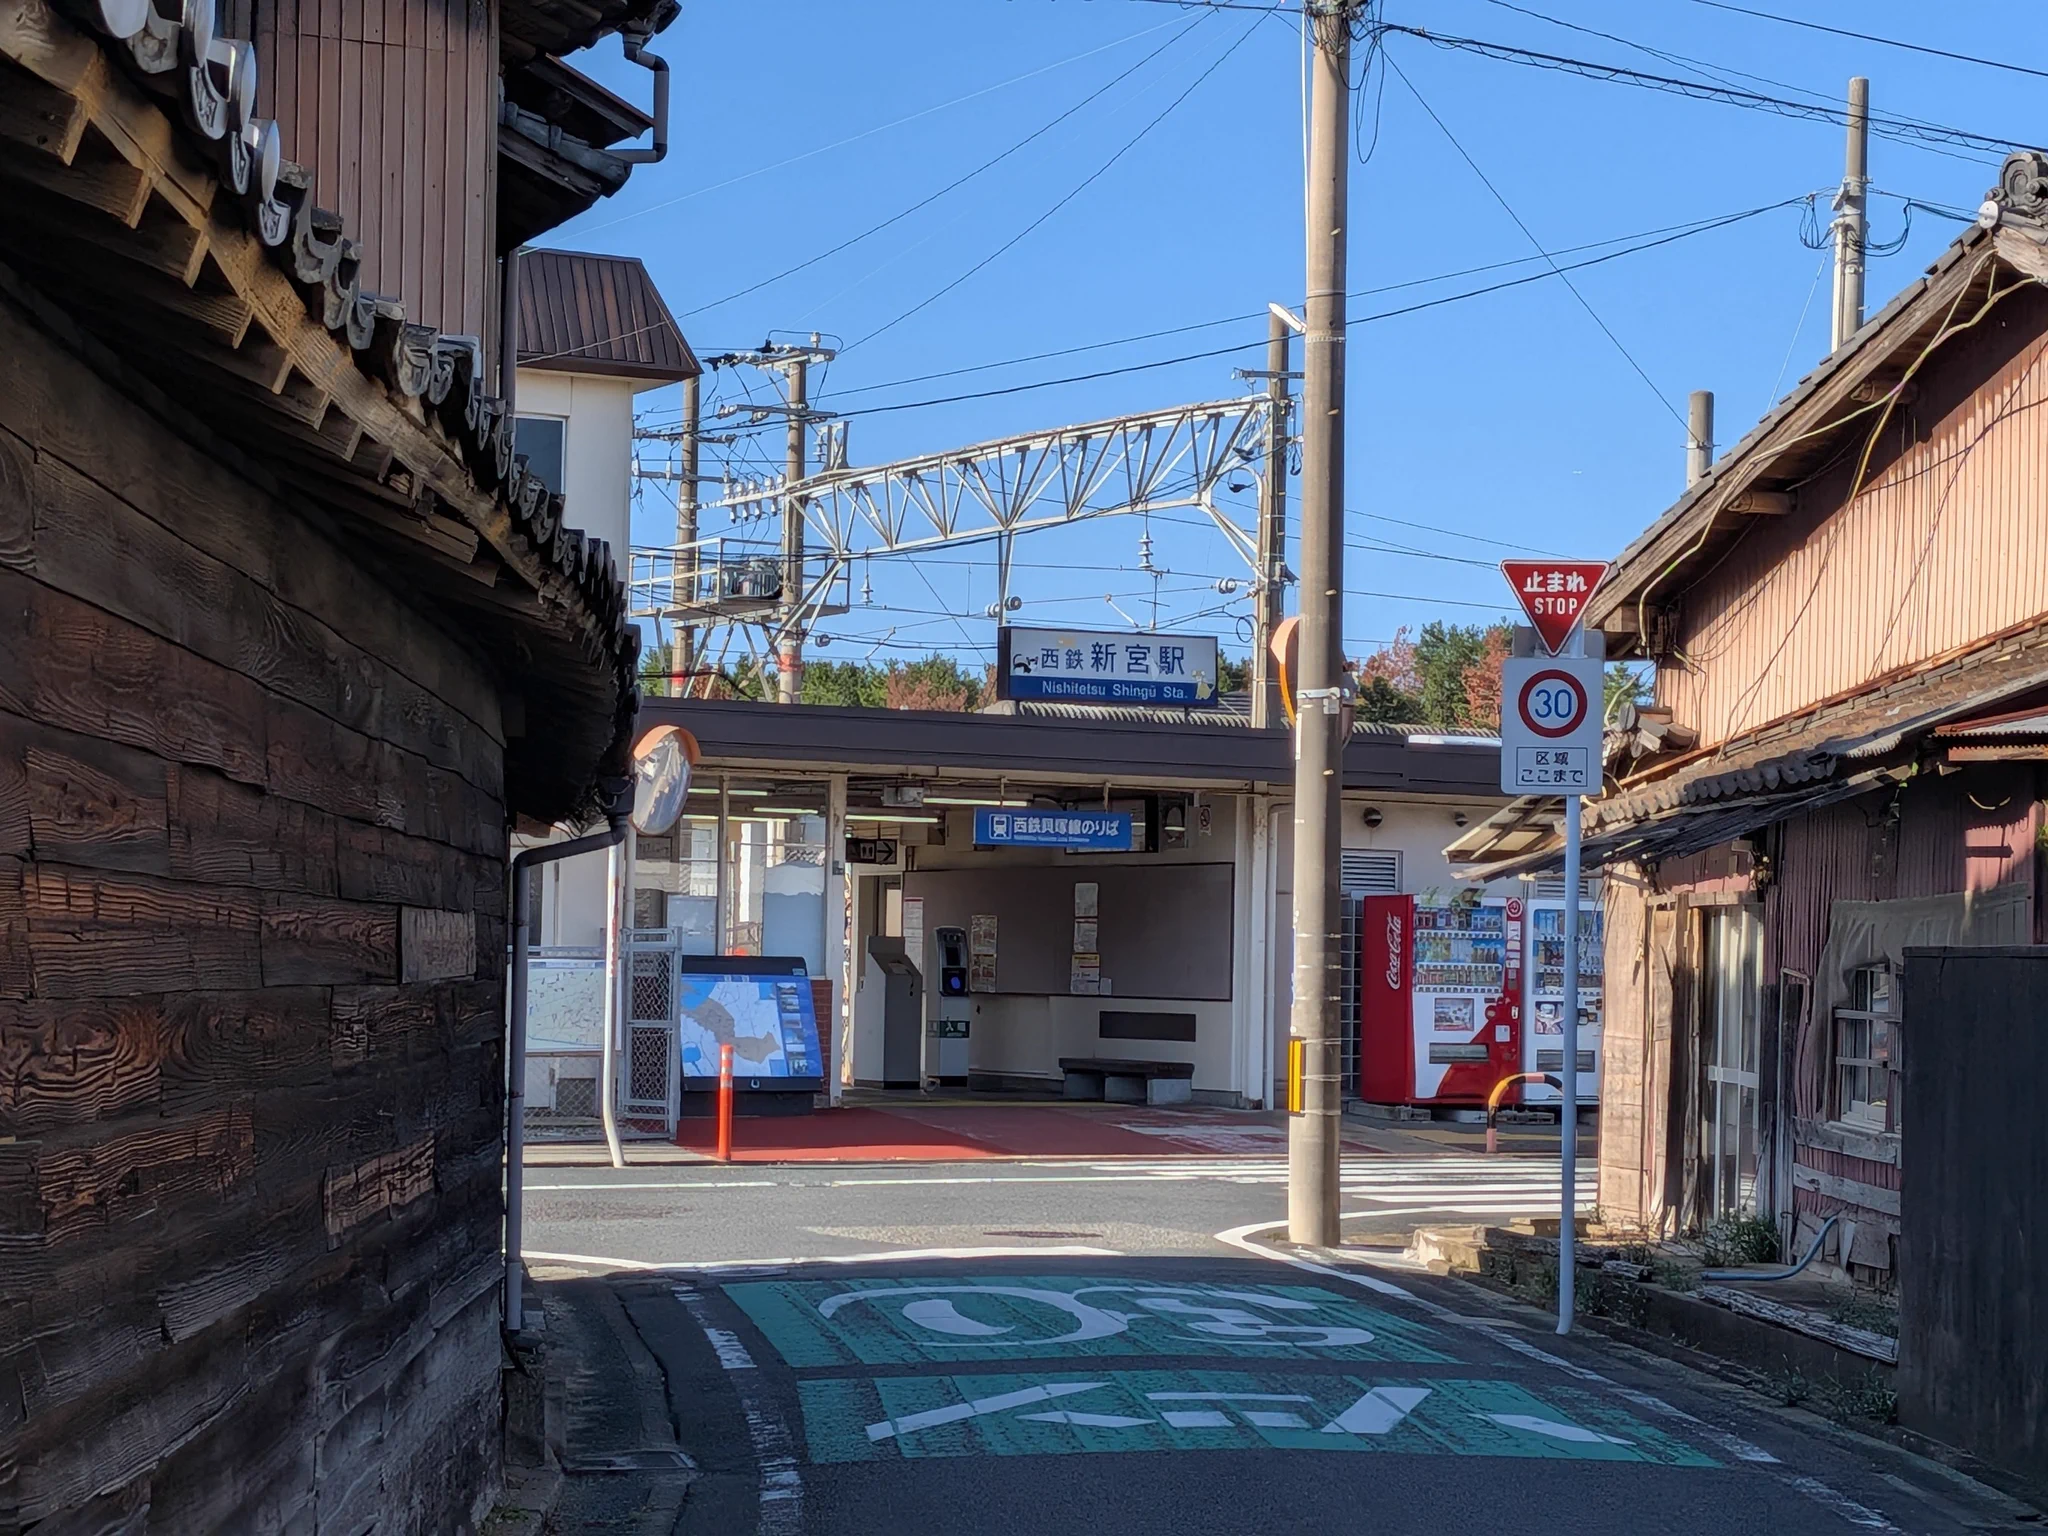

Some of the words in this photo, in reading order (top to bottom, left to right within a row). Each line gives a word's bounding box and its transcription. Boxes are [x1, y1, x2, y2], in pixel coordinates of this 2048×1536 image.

[1523, 571, 1587, 593] 止まれ
[1534, 597, 1578, 616] STOP
[1041, 641, 1184, 676] 西鉄新宮駅
[1042, 680, 1105, 696] Nishitetsu
[1163, 686, 1188, 699] Sta.
[1534, 688, 1573, 719] 30
[1520, 768, 1584, 784] ここまで
